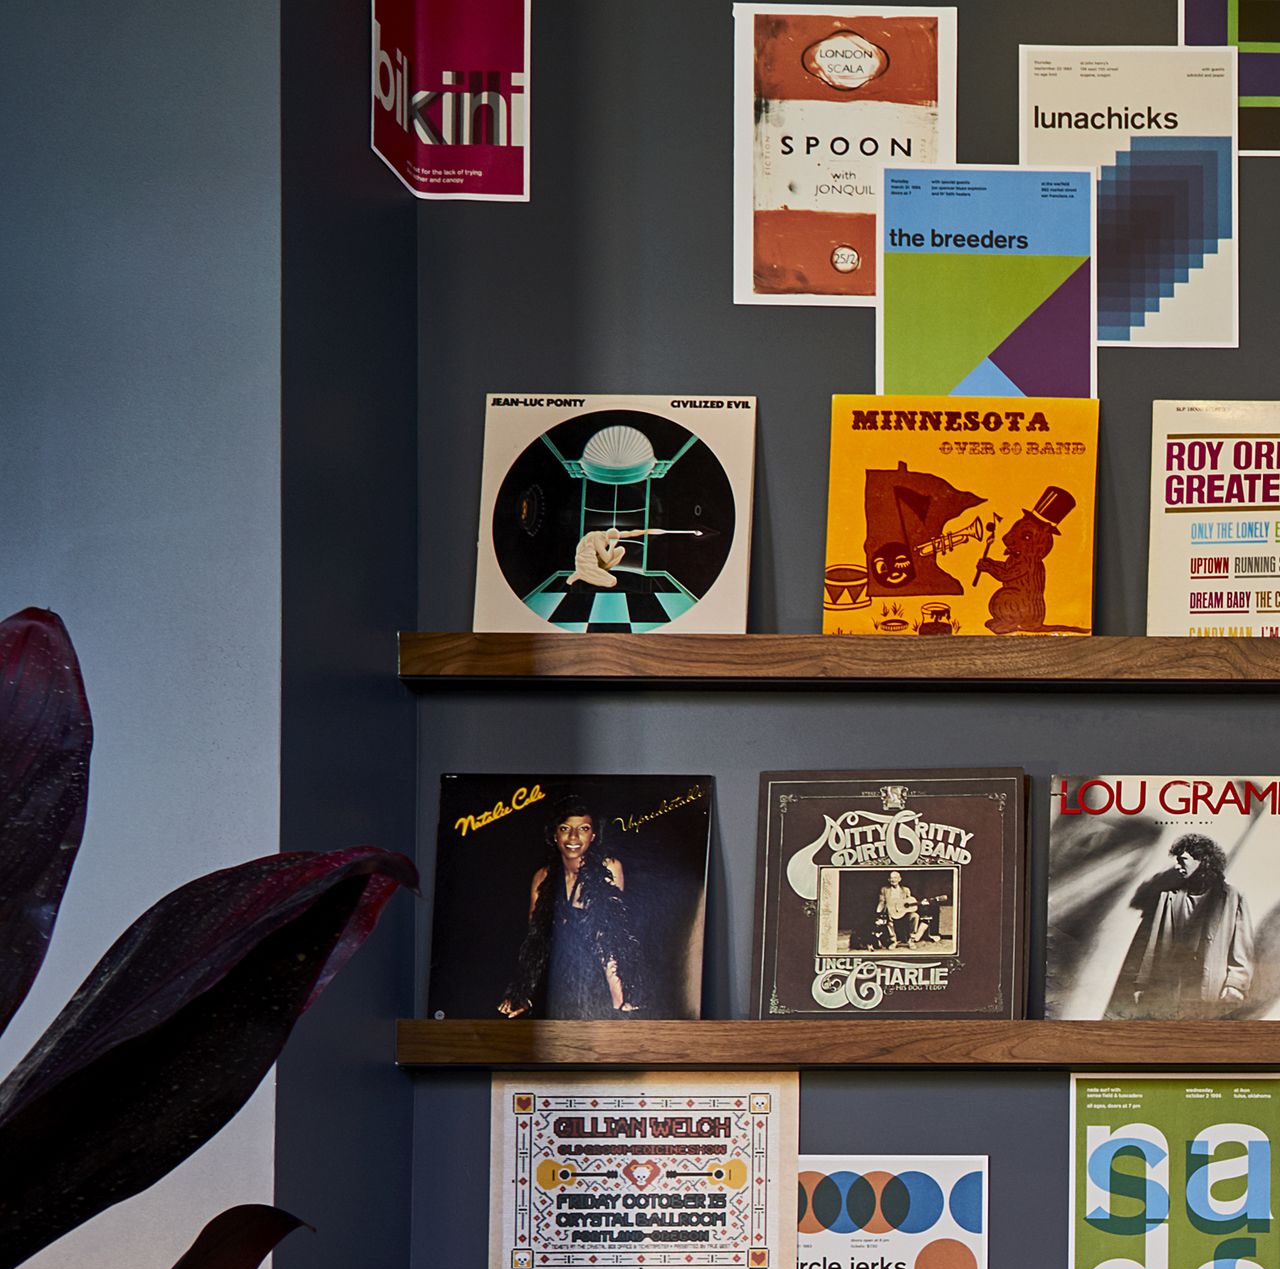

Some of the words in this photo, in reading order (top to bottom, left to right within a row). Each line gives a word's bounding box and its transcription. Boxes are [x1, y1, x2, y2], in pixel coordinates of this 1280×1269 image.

[819, 48, 873, 59] LONDON
[827, 63, 864, 74] SCALA
[1033, 105, 1179, 130] lunachicks
[780, 135, 912, 157] SPOON
[830, 169, 857, 181] with
[814, 183, 876, 197] JONQUIL
[889, 229, 925, 247] the
[931, 229, 1029, 250] breeders
[491, 397, 545, 407] JEAN-LUC
[546, 398, 586, 408] PONTY
[670, 399, 724, 409] CIVILIZED
[726, 399, 751, 409] EVIL
[851, 409, 1050, 432] MINNESOTA
[1166, 440, 1224, 471] ROY
[1191, 522, 1215, 540] ONLY
[1216, 522, 1233, 539] THE
[1236, 521, 1270, 538] LONELY
[1190, 556, 1229, 575] UPTOWN
[1234, 555, 1276, 573] RUNNING
[1189, 591, 1224, 609] DREAM
[1226, 591, 1251, 609] BABY
[1256, 591, 1273, 608] THE
[1060, 780, 1147, 815] LOU
[553, 1116, 648, 1139] GILLIAN
[650, 1116, 731, 1138] WELCH
[556, 1193, 621, 1210] FRIDAY
[555, 1212, 634, 1228] CRYSTAL
[635, 1212, 726, 1227] BALLROOM
